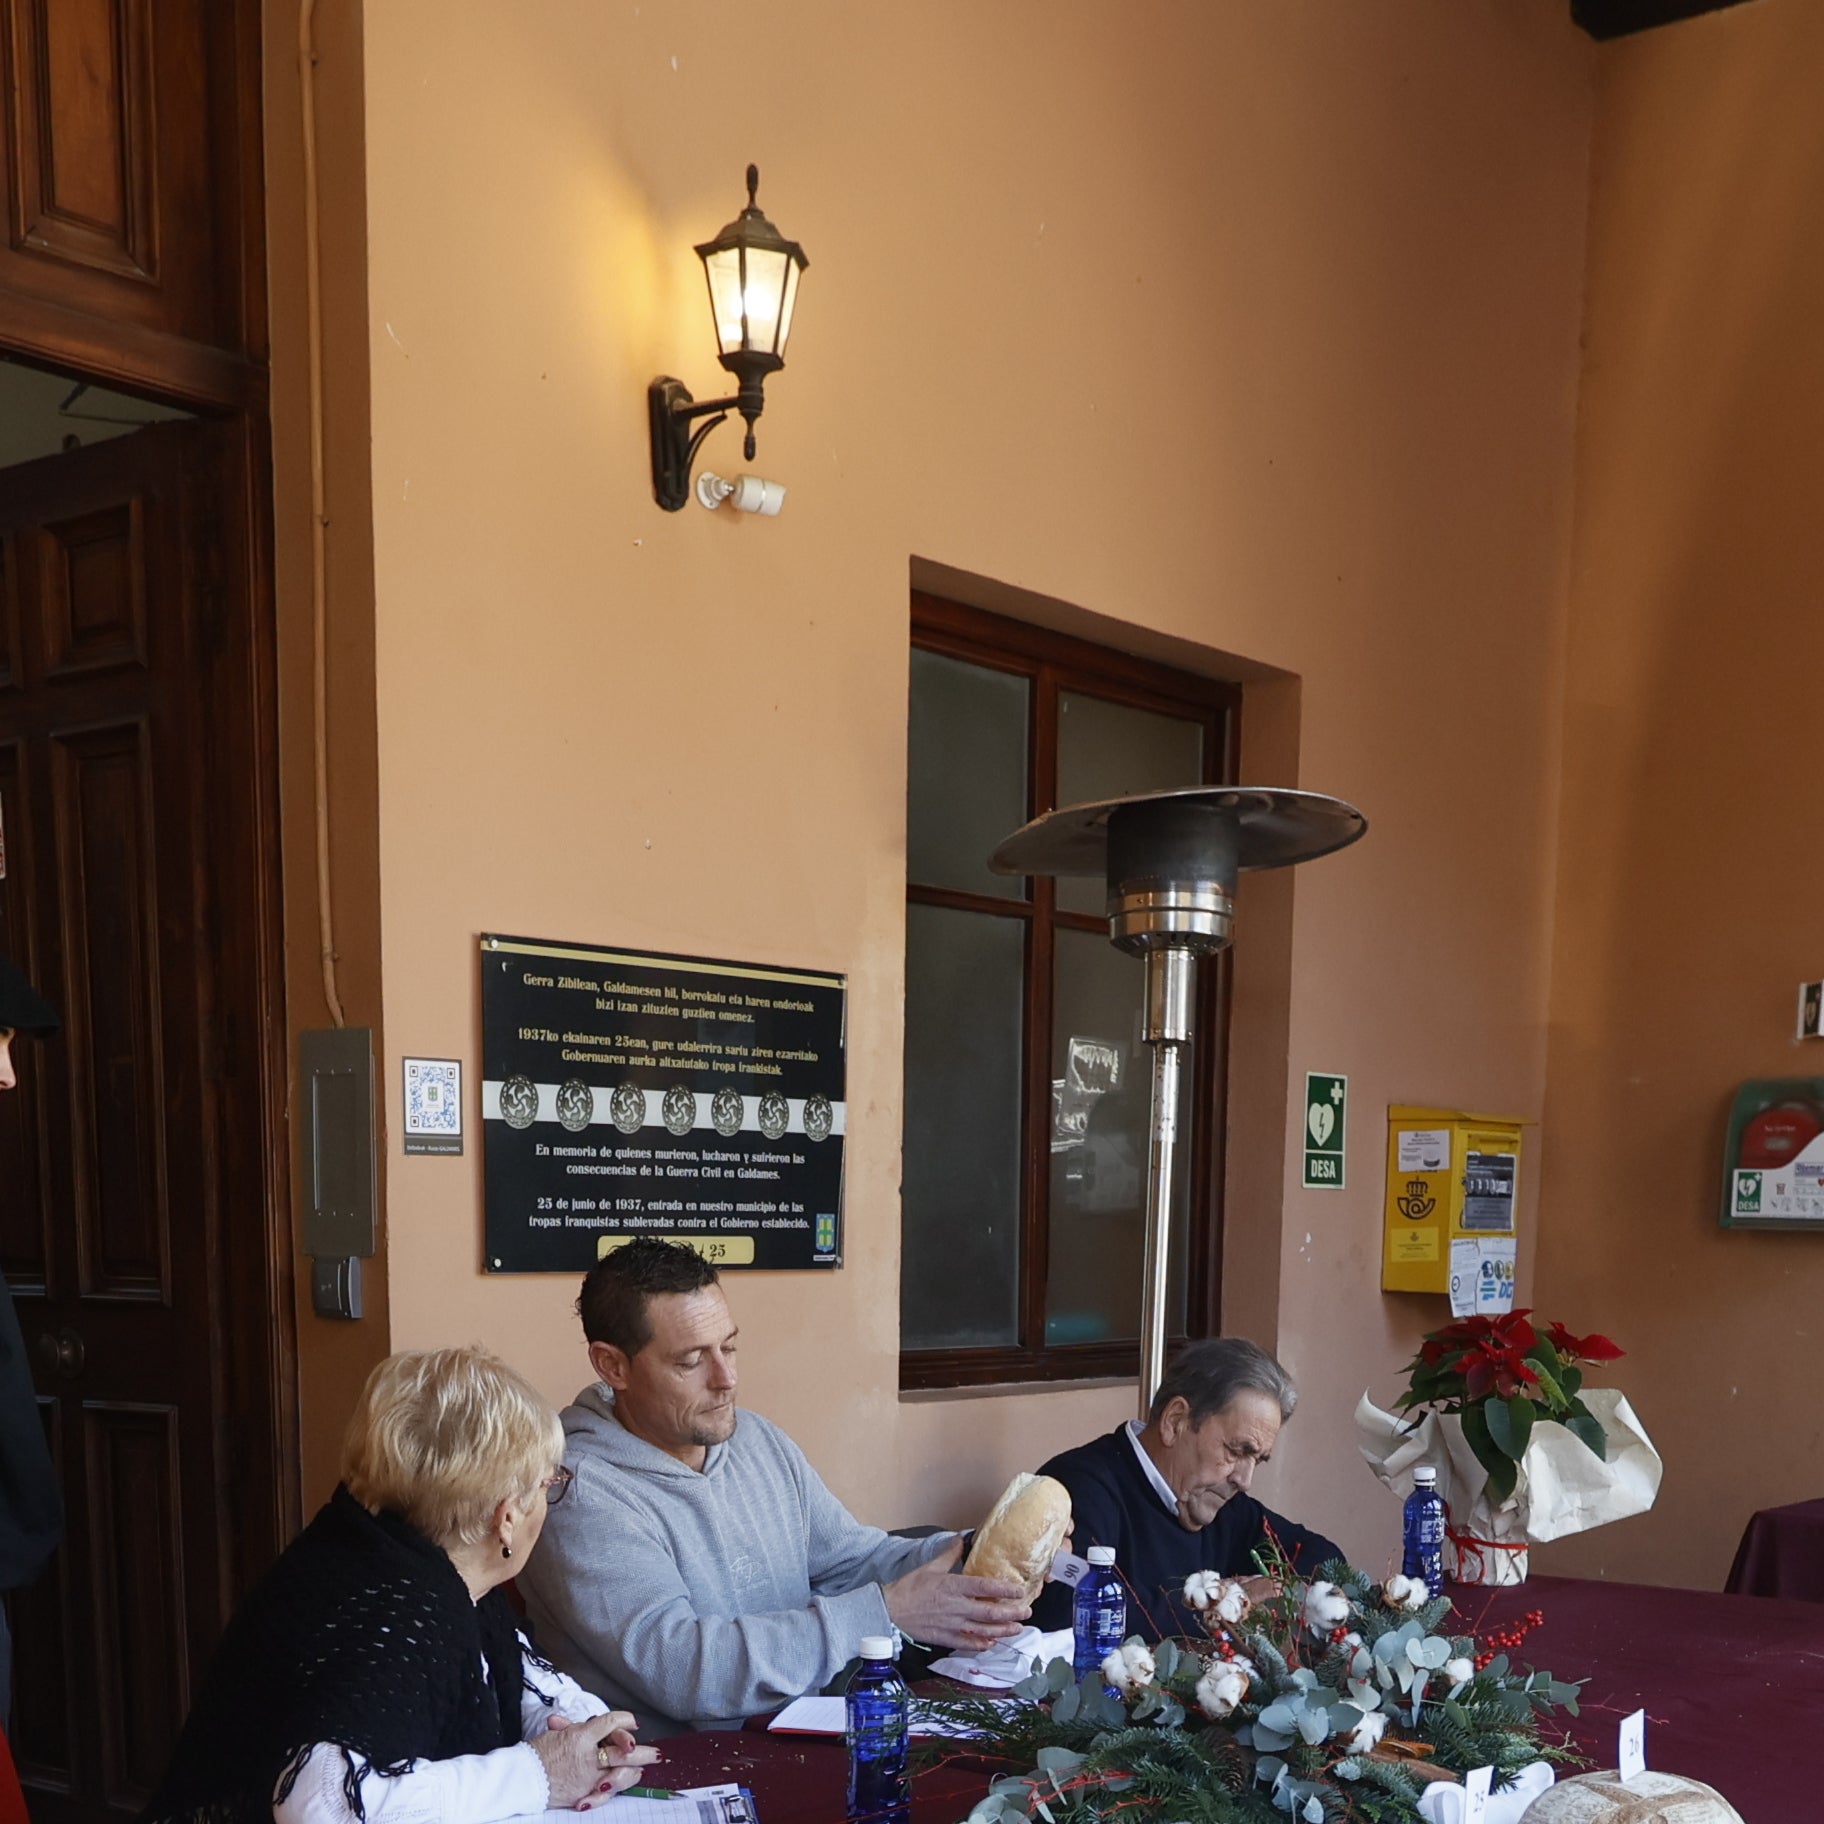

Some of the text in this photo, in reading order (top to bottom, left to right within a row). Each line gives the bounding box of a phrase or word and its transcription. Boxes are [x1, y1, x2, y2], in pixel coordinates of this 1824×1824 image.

[523, 973, 814, 1013] Gerra Zibilean, Galdamesen hil, borrokatu eta haren ondorioak
[596, 998, 755, 1023] bizi izan zituzten guztien omenez.
[518, 1027, 559, 1042] 1937ko
[562, 1031, 611, 1046] ekainaren
[652, 1041, 674, 1049] gure
[677, 1040, 722, 1054] udalerrira
[725, 1044, 748, 1057] sartu
[751, 1046, 773, 1058] ziren
[776, 1048, 818, 1062] ezarritako
[562, 1049, 783, 1076] Gobernuaren aurka altxatutako tropa frankistak.
[535, 1143, 805, 1165] En memoria de quienes murieron, lucharon y sufrieron las
[566, 1165, 781, 1180] consecuencias de la Guerra Civil en Galdames.
[1311, 1159, 1336, 1178] DESA
[537, 1197, 804, 1214] 25 de junio de 1937, entrada en nuestro municipio de las
[1738, 1201, 1759, 1210] DESA
[529, 1215, 810, 1229] tropas franquistas sublevadas contra el Gobierno establecido.
[709, 1244, 726, 1257] 25
[1629, 1732, 1640, 1757] 26
